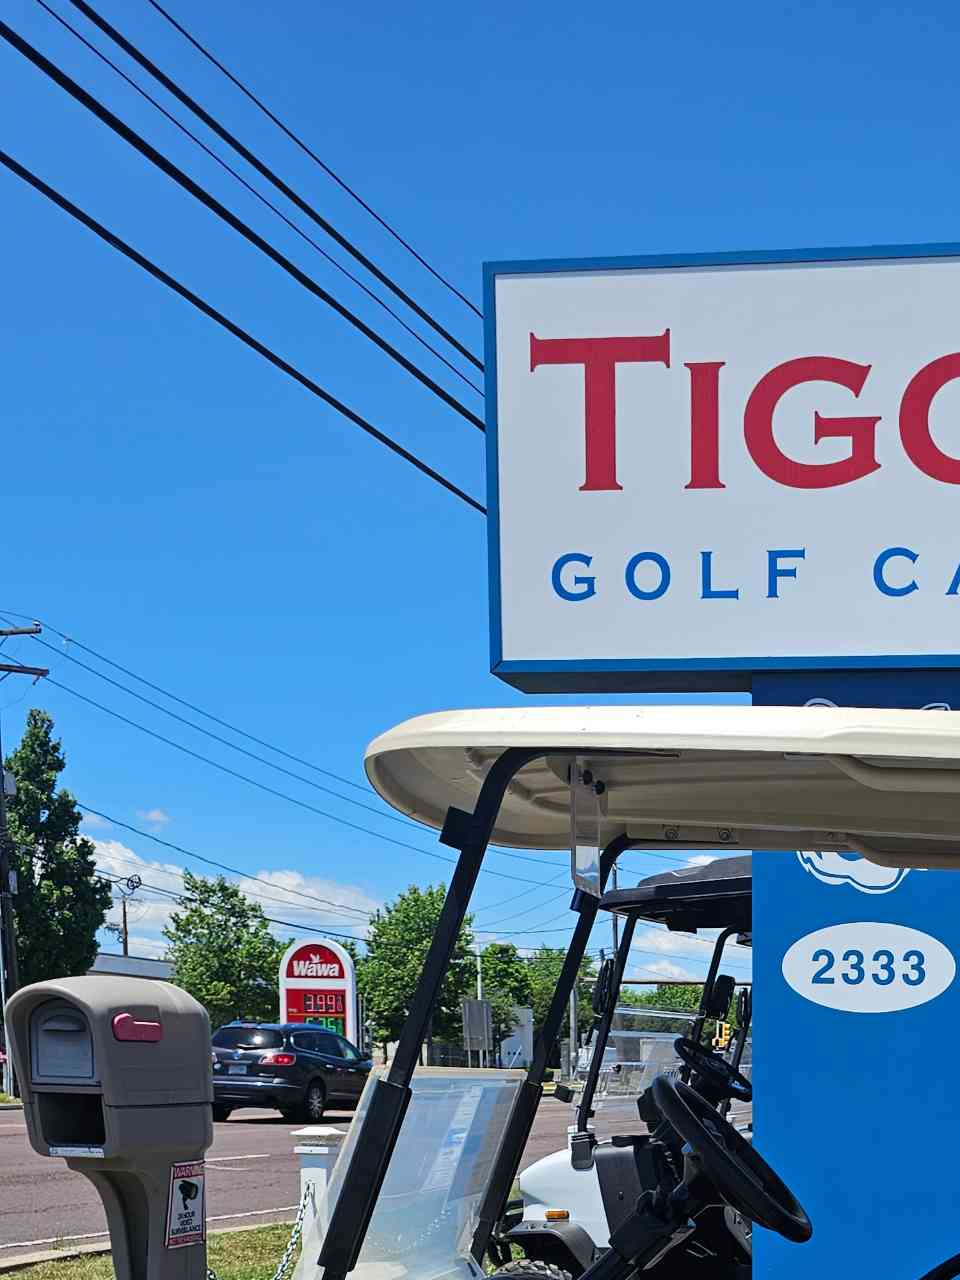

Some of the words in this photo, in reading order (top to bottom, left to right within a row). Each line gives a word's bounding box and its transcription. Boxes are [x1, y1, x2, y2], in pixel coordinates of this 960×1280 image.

[549, 546, 808, 603] GOLF
[292, 960, 340, 977] Wawa
[810, 947, 928, 988] 2333
